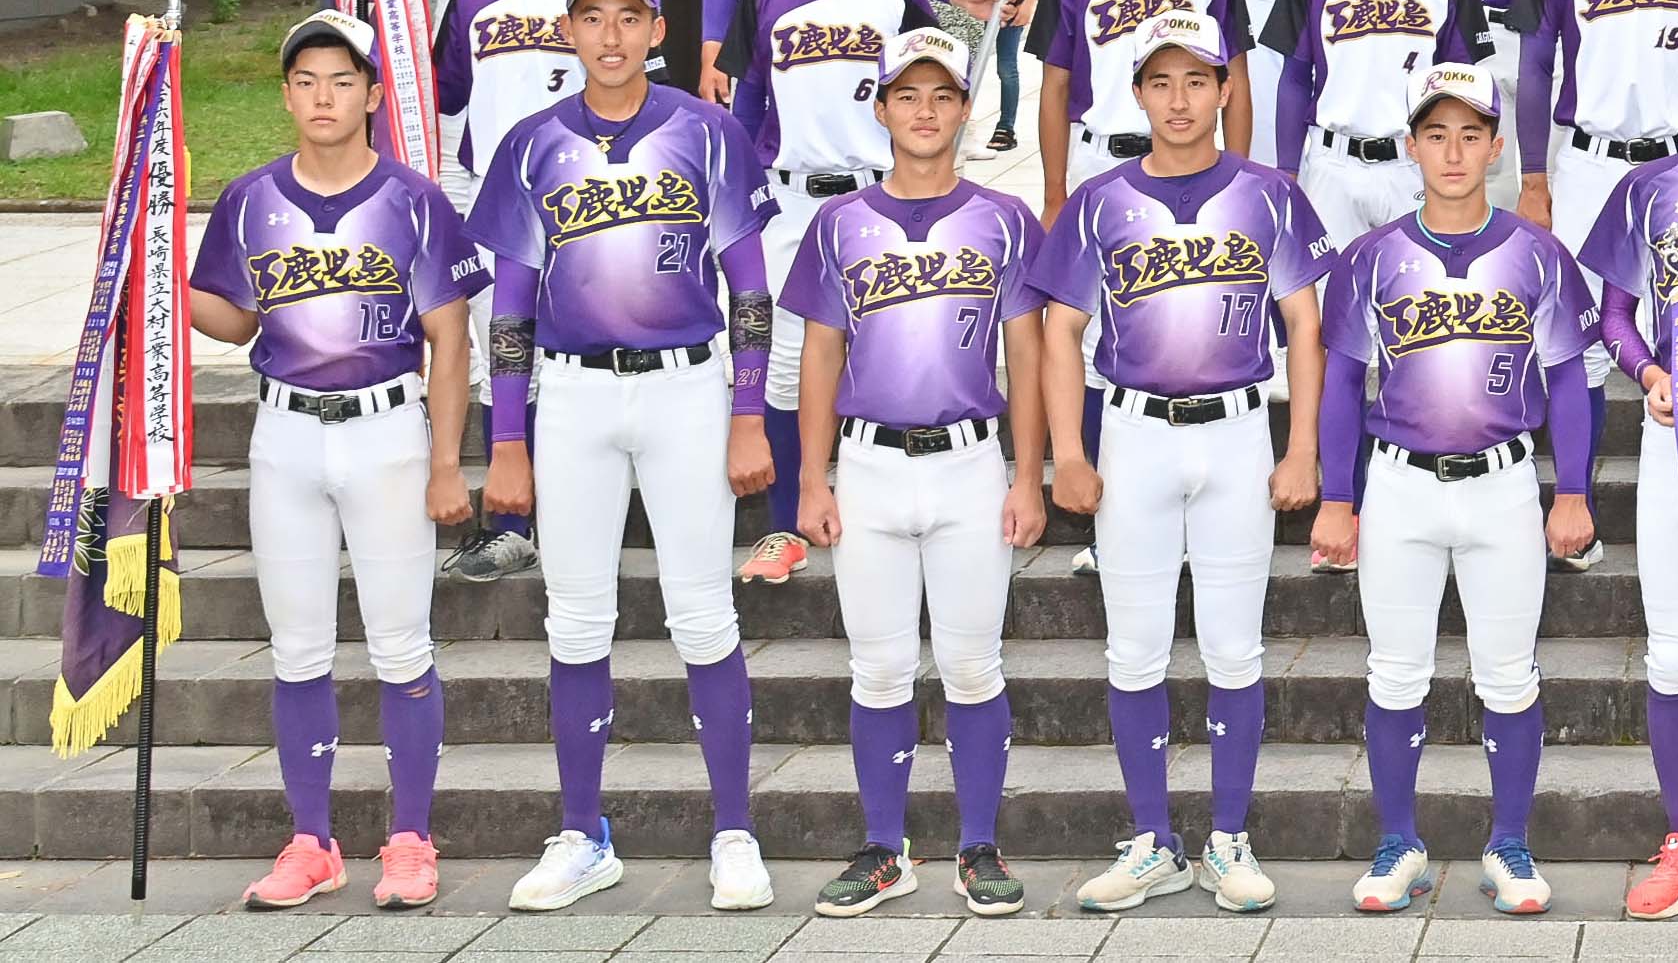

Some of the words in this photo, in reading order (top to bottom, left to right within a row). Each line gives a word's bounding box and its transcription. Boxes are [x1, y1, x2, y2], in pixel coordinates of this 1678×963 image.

[770, 22, 883, 72] 工鹿児島
[898, 33, 954, 58] ROKKO
[1145, 18, 1200, 44] ROKKO
[547, 69, 569, 92] 3
[853, 78, 875, 102] 6
[1420, 71, 1475, 97] ROKKO
[148, 161, 176, 216] 優勝
[542, 169, 703, 249] 工鹿児島
[656, 232, 691, 275] 21
[1111, 230, 1268, 309] 工鹿児島
[248, 243, 402, 313] 工鹿児島
[842, 246, 996, 322] 工鹿児島
[146, 225, 174, 442] 長崎県立大村工業高等学校
[957, 307, 981, 351] 7
[1218, 292, 1259, 337] 17
[1381, 288, 1534, 359] 工鹿児島
[736, 367, 761, 386] 21
[1487, 352, 1514, 396] 5
